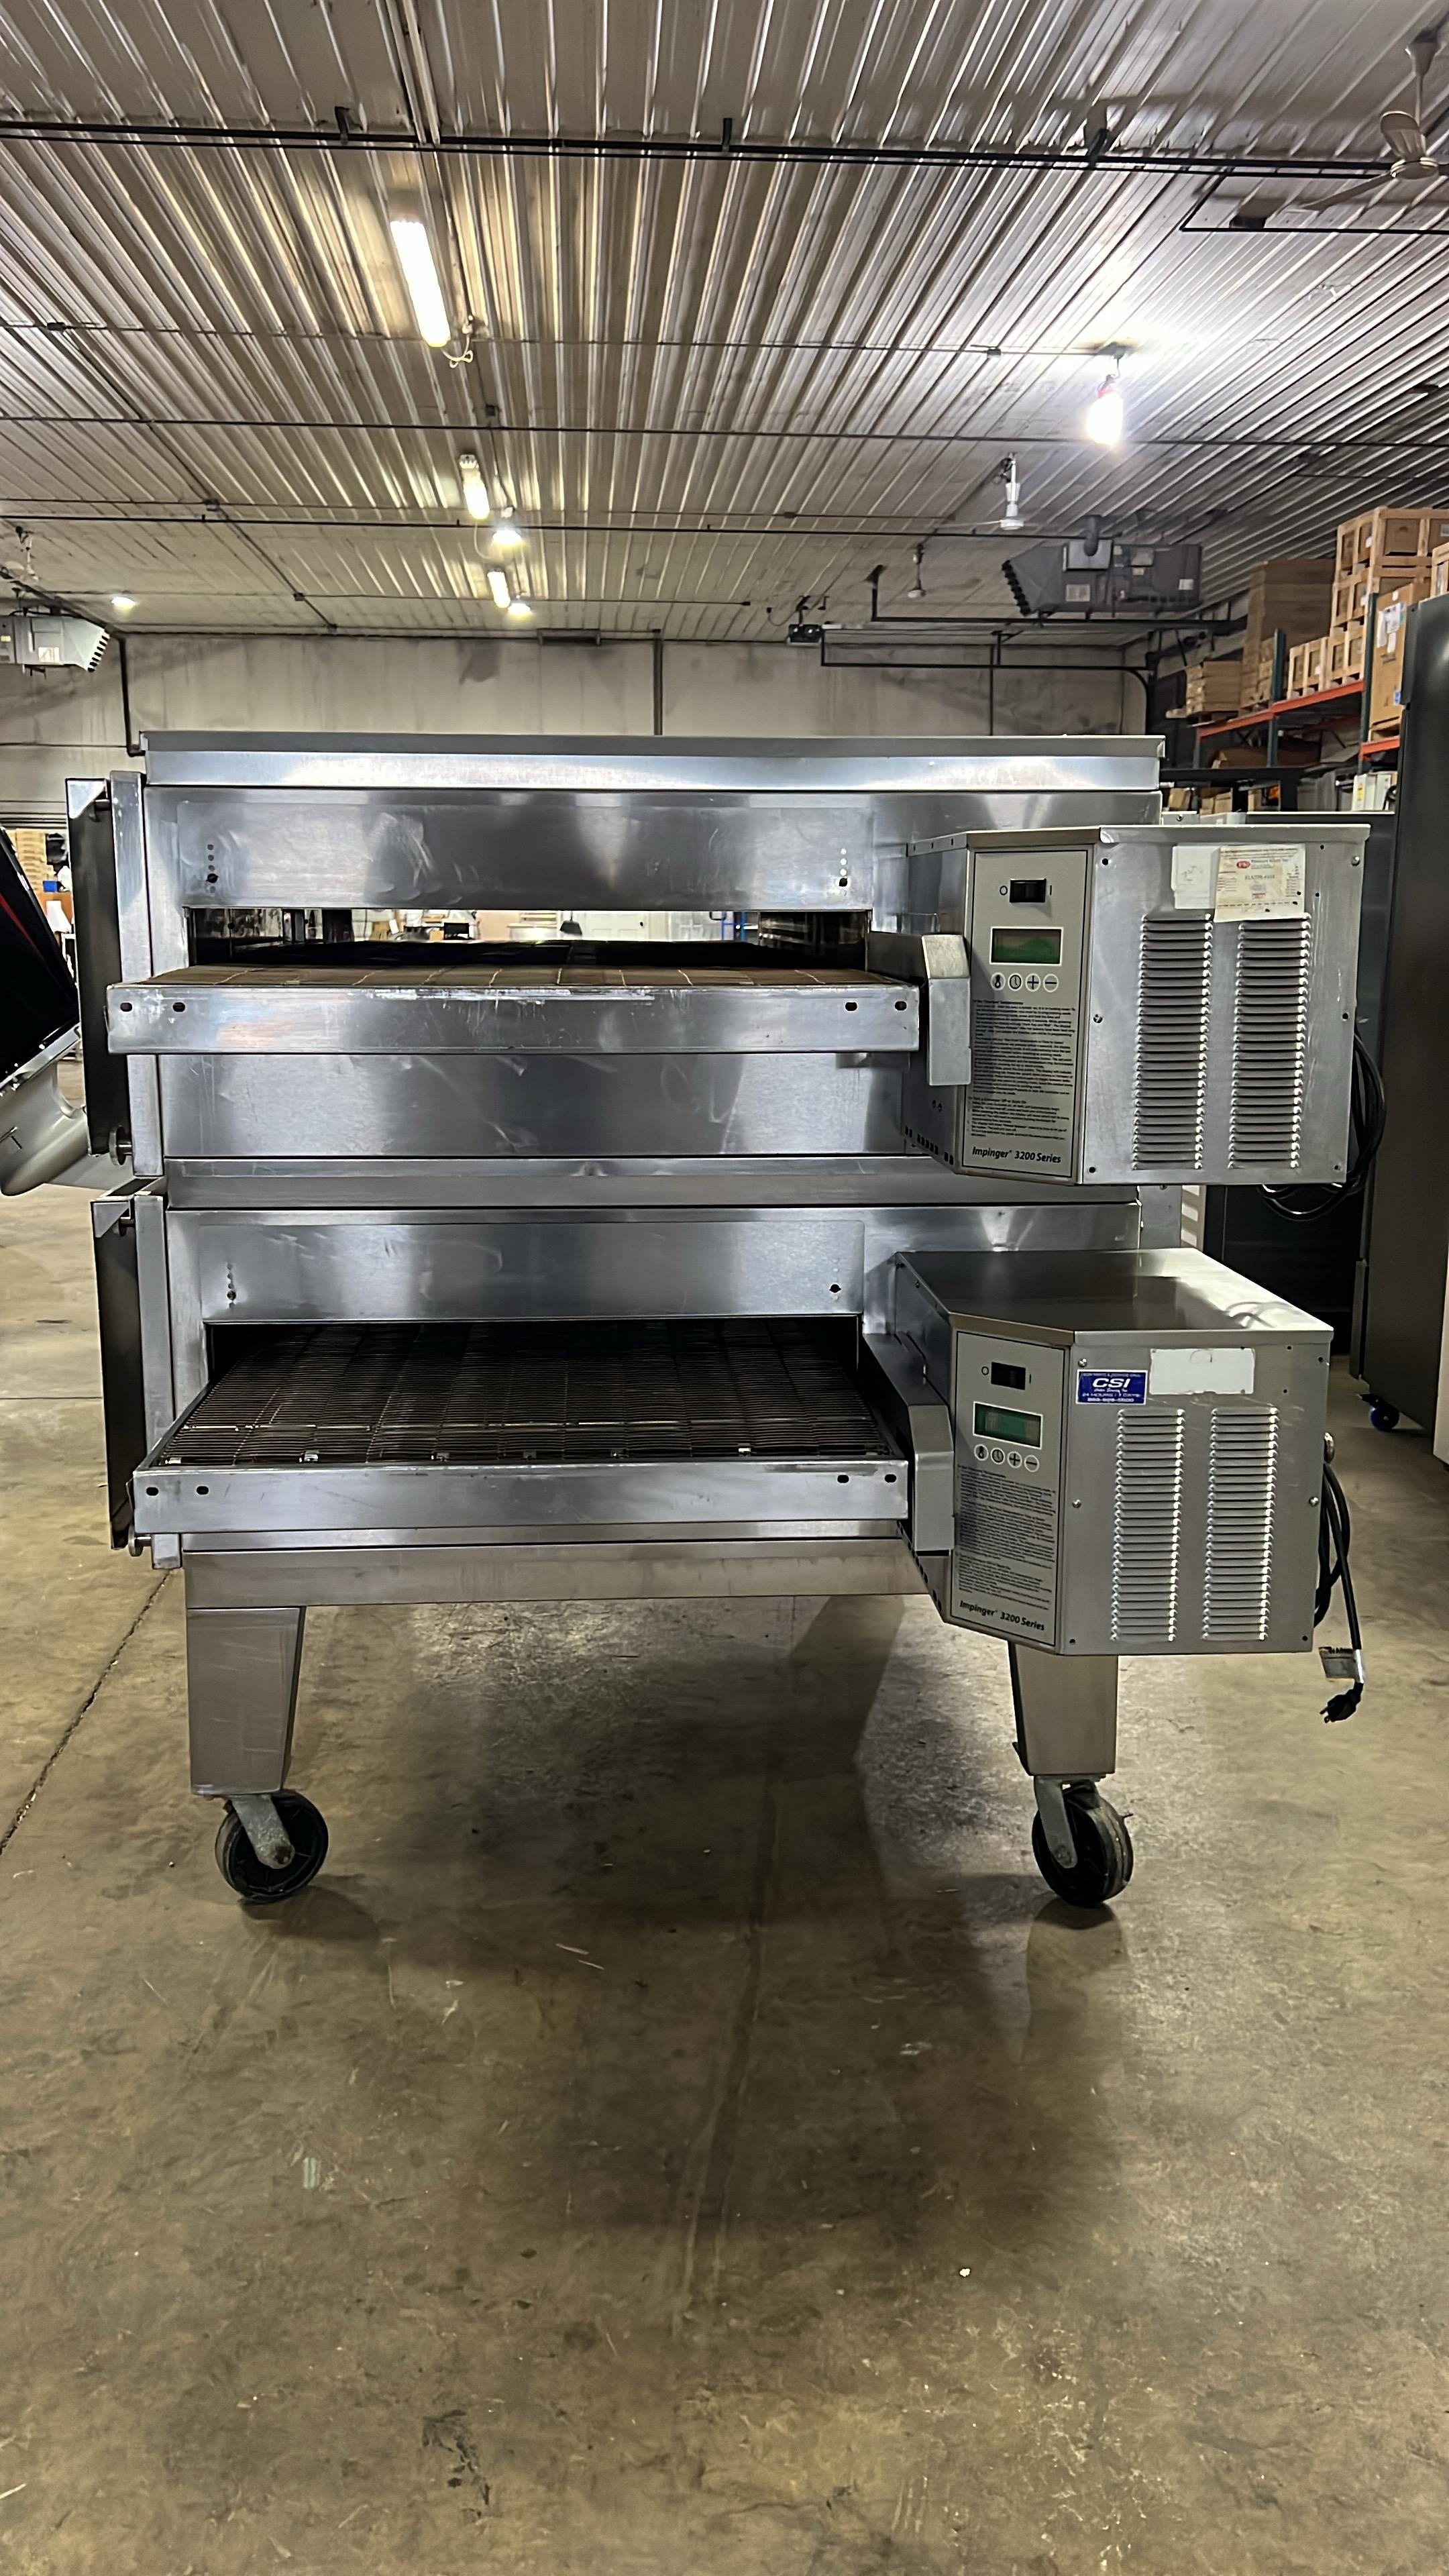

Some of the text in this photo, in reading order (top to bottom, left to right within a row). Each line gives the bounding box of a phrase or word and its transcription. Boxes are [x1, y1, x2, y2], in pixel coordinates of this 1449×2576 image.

[972, 1146, 1061, 1163] Impinger 3200 Series
[1092, 1378, 1131, 1388] CSI
[960, 1600, 1045, 1631] Impinger 3200 Series
